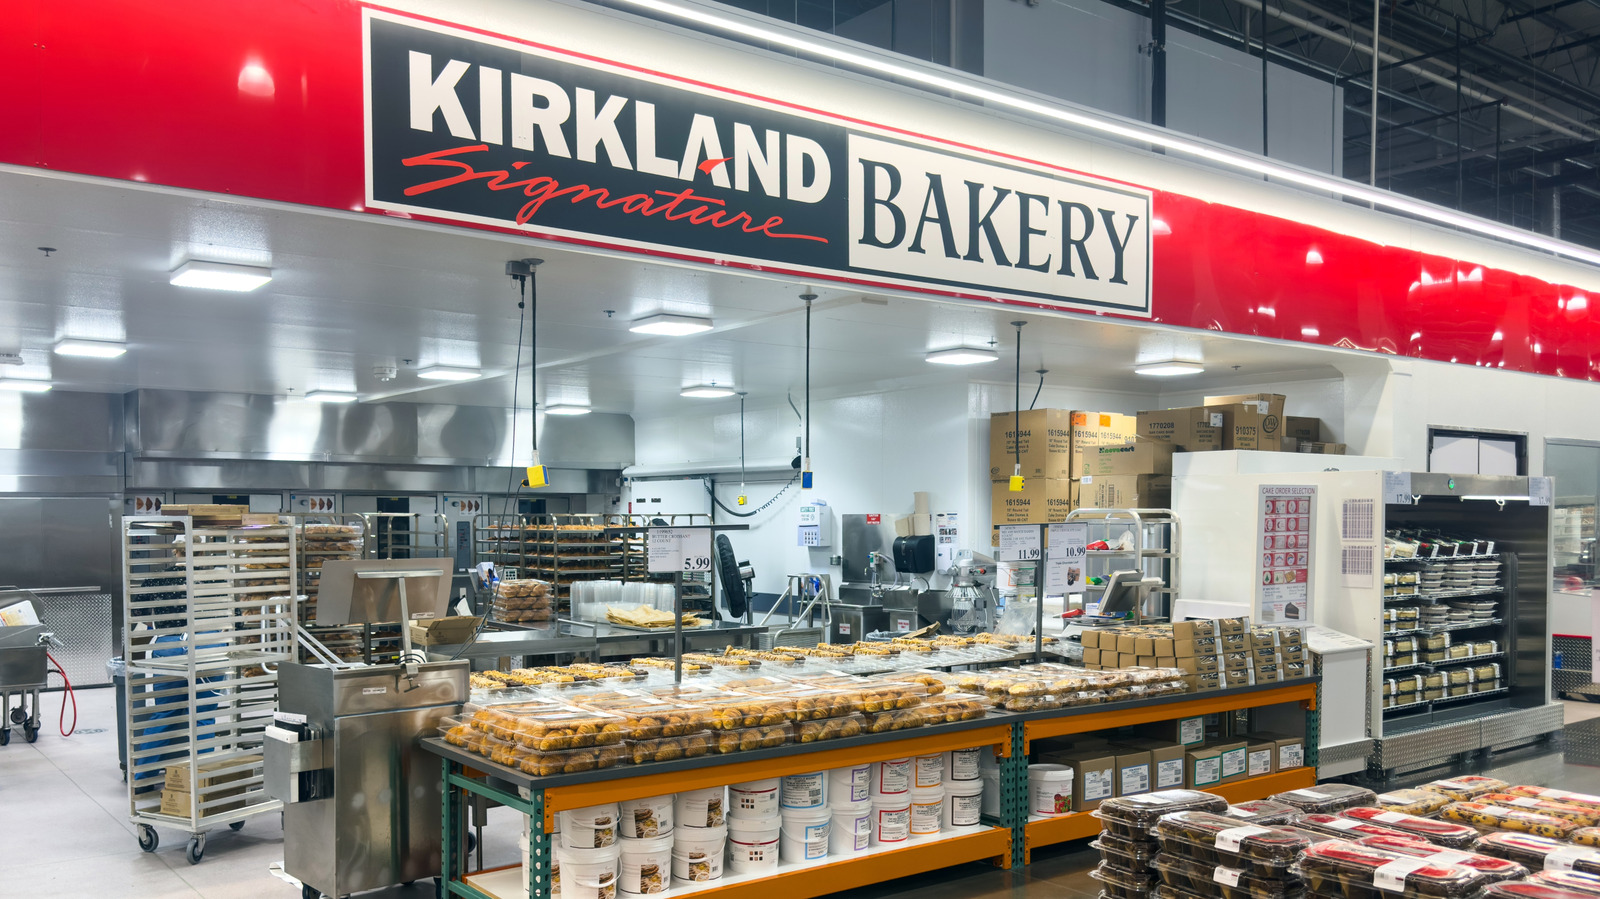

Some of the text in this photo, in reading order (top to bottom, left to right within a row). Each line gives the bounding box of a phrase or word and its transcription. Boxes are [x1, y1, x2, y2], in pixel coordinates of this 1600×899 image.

[409, 49, 831, 204] KIRKLAND
[401, 144, 828, 243] Signature
[857, 157, 1139, 285] BAKERY
[1005, 430, 1031, 439] 161944
[1074, 430, 1098, 438] 1615944
[1235, 426, 1257, 436] 910375
[1019, 549, 1040, 559] 11.99
[1066, 547, 1086, 557] 10.99
[684, 557, 710, 570] 5.99
